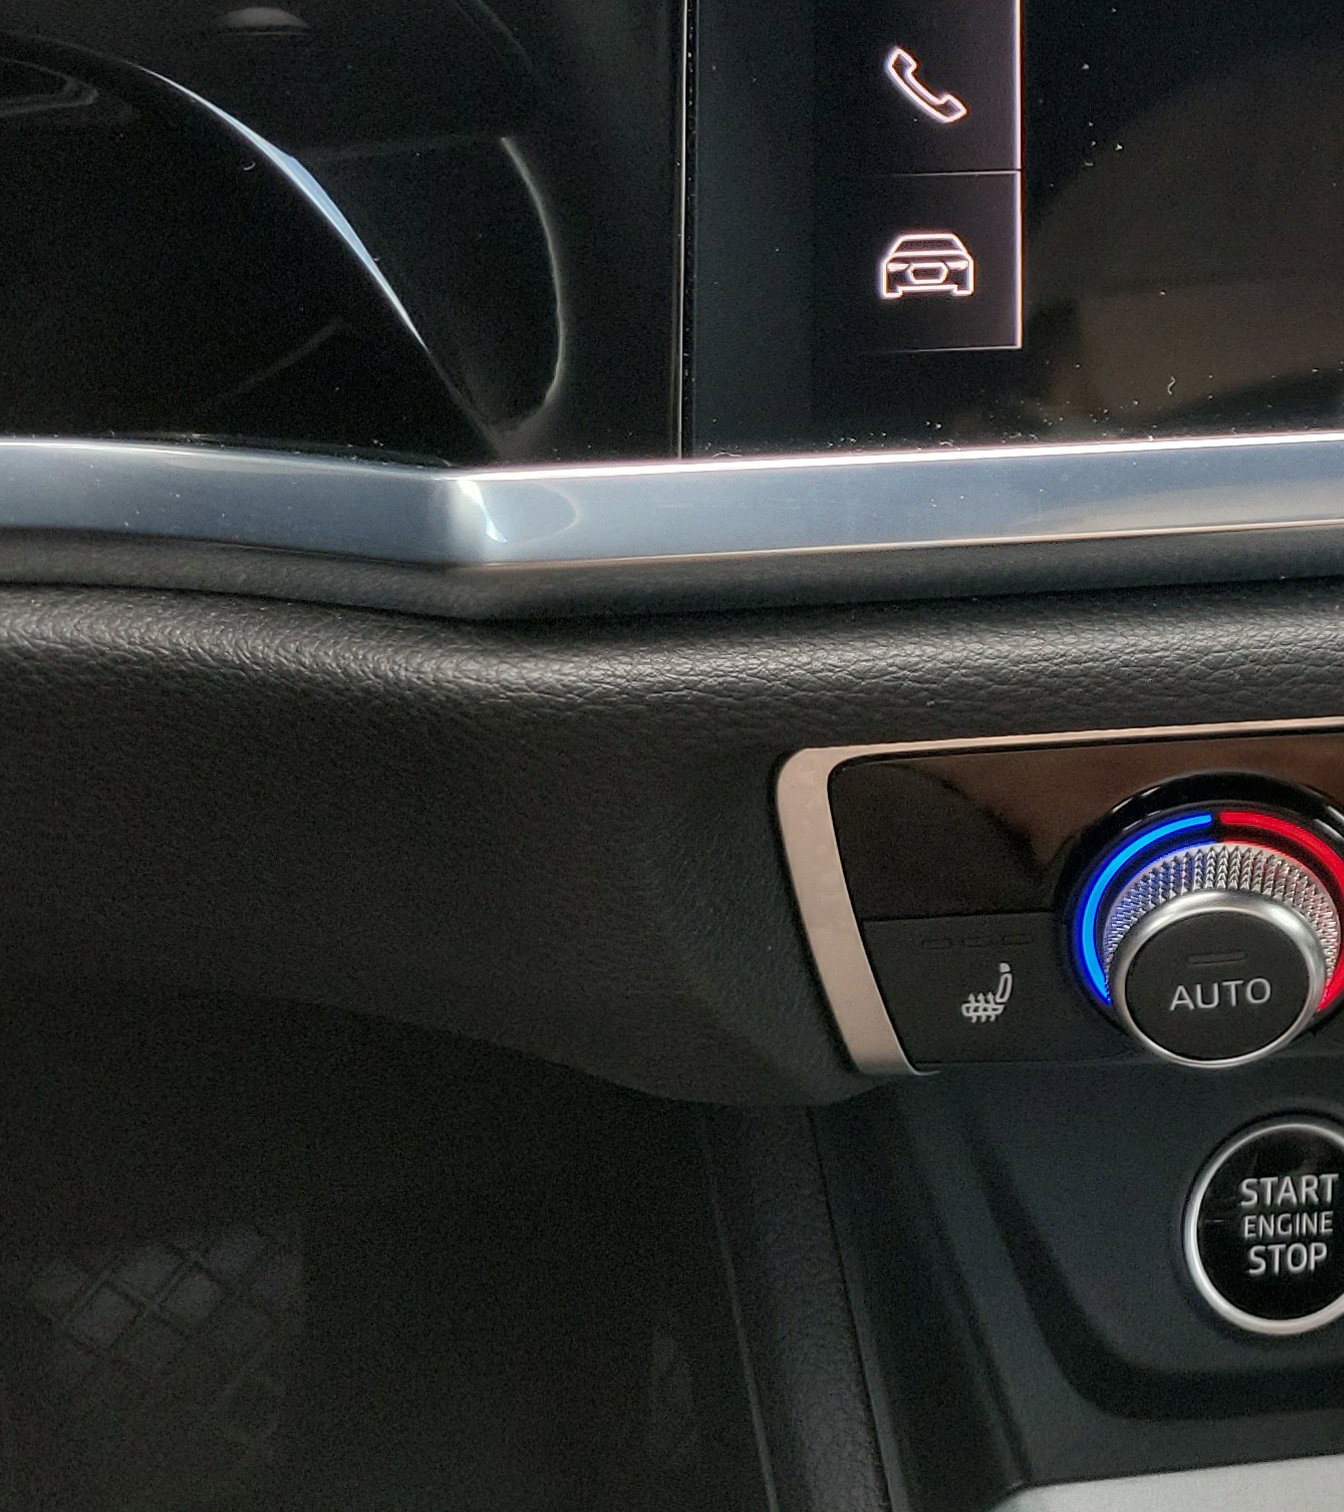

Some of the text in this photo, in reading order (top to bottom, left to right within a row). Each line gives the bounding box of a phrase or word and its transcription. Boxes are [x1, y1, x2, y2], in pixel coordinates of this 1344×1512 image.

[1169, 977, 1271, 1011] AUTO
[1240, 1173, 1339, 1208] START
[1243, 1211, 1333, 1239] ENGINE
[1248, 1242, 1328, 1275] STOP
